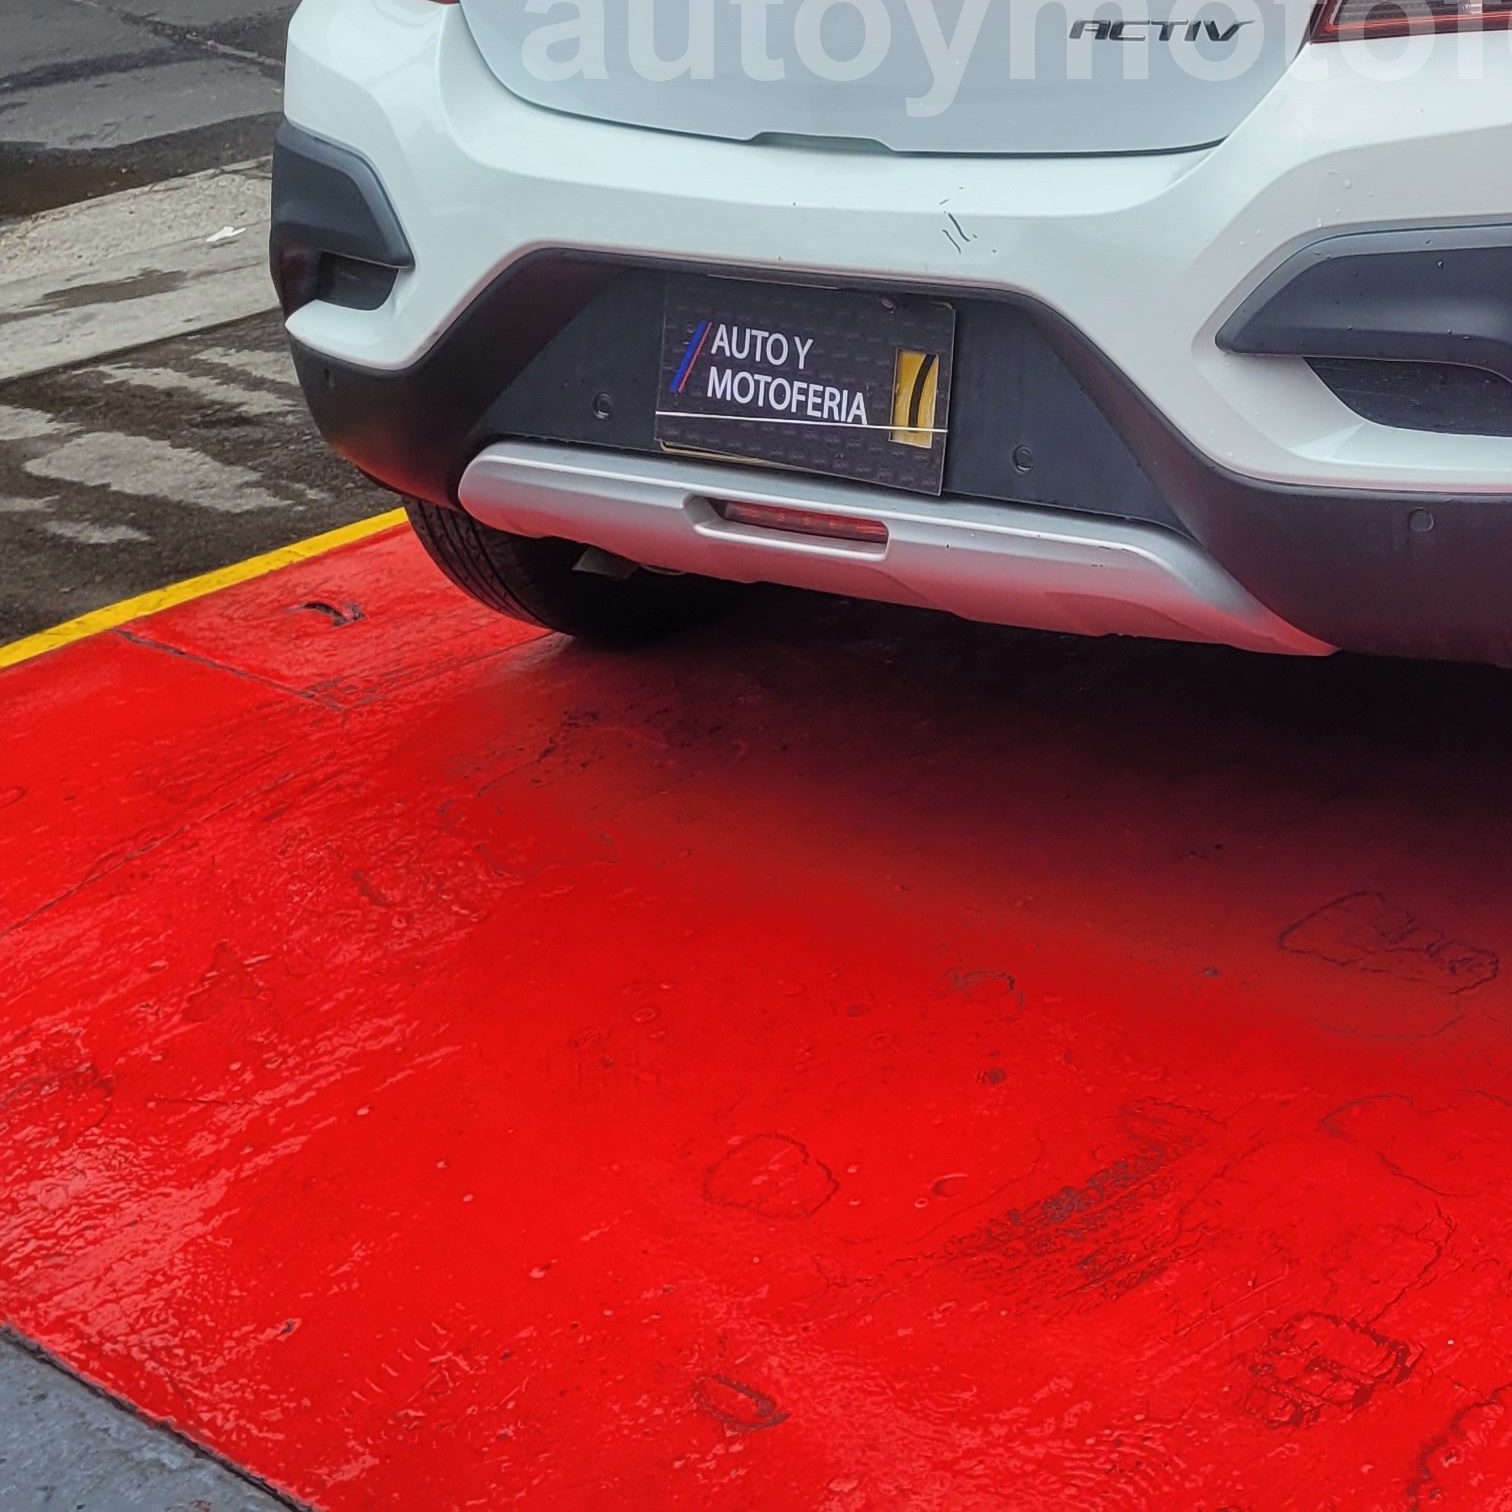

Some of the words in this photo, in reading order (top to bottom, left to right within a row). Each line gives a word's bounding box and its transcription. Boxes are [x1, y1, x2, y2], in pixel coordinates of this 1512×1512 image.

[1069, 20, 1254, 41] ACTIV
[711, 324, 788, 365] AUTO
[794, 336, 814, 369] Y
[707, 366, 867, 425] MOTOFERIA
